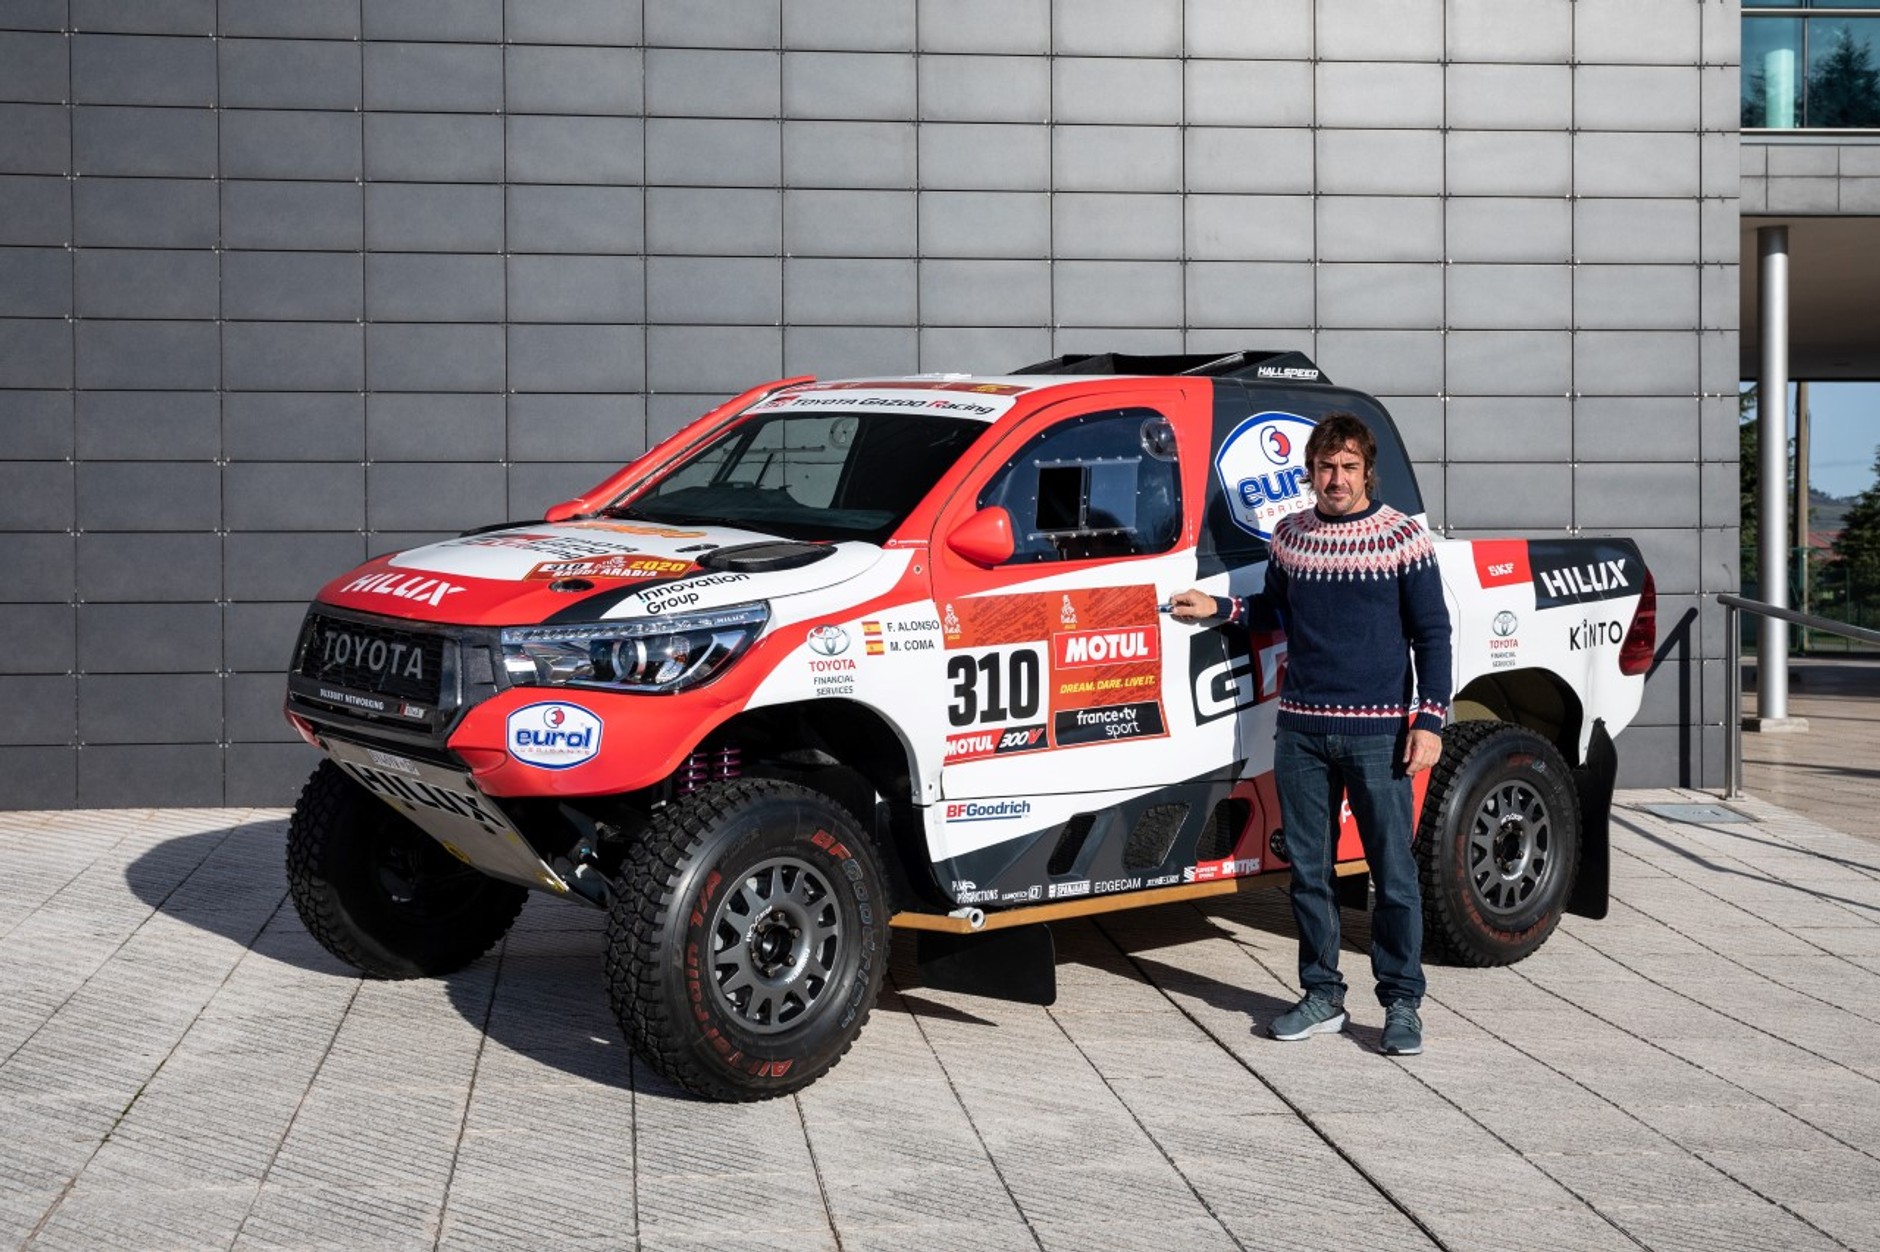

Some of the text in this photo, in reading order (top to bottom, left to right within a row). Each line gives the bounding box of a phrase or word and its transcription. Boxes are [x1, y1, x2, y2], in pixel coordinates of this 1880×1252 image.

[1257, 366, 1319, 379] HALLSPEED
[1238, 465, 1307, 508] eur
[1245, 498, 1317, 522] LUBRICA
[599, 568, 658, 577] ARABIA
[629, 560, 685, 572] 2020
[1487, 563, 1514, 576] SKF
[1540, 558, 1629, 598] HILUX
[340, 573, 468, 606] HILUX
[647, 591, 699, 615] Group
[887, 620, 940, 632] F. ALONSO
[890, 640, 935, 651] M. COMA
[1065, 632, 1148, 663] MOTUL
[1489, 639, 1518, 649] TOYOTA
[323, 630, 424, 680] TOYOTA
[808, 659, 856, 672] TOYOTA
[814, 675, 854, 685] FINANCIAL
[947, 649, 1040, 727] 310
[816, 686, 853, 696] SERVICES
[516, 727, 593, 748] eurol
[1105, 722, 1140, 741] sport
[945, 728, 1044, 756] MOTUL 300V
[342, 761, 506, 829] HILUX
[946, 800, 1031, 818] BFGoodrich
[1094, 878, 1141, 893] EDGECAM
